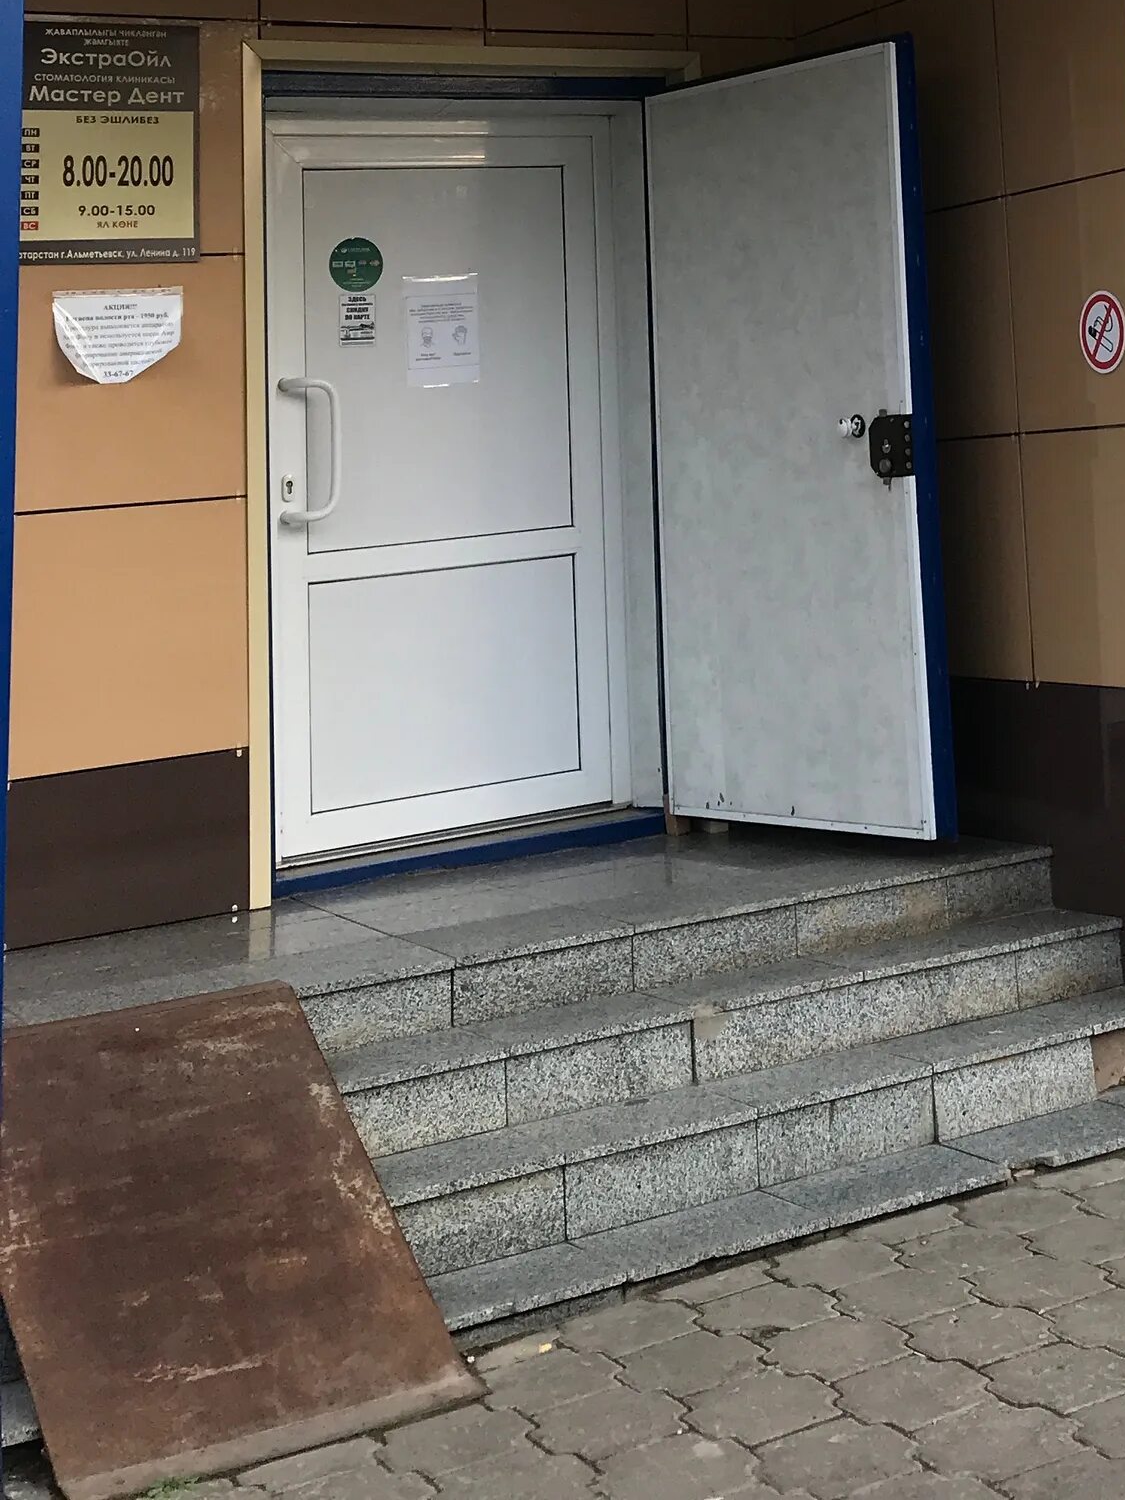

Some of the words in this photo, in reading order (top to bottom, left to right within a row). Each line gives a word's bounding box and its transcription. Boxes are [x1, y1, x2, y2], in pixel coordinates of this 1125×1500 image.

[41, 48, 172, 69] ЭкстраОйл
[34, 73, 113, 83] СТОМАТОЛОГИЯ
[115, 75, 175, 84] КЛИНИКАСЫ
[29, 85, 121, 106] Мастер
[127, 88, 185, 105] Дент
[76, 115, 97, 124] БЕЗ
[100, 116, 159, 124] ЭШЛИБЕЗ
[24, 160, 37, 168] СР
[62, 155, 174, 187] 8.00-20.00
[78, 204, 156, 217] 9.00-15.00
[23, 222, 36, 230] ВС
[140, 248, 171, 257] Ленина
[182, 247, 196, 257] 119
